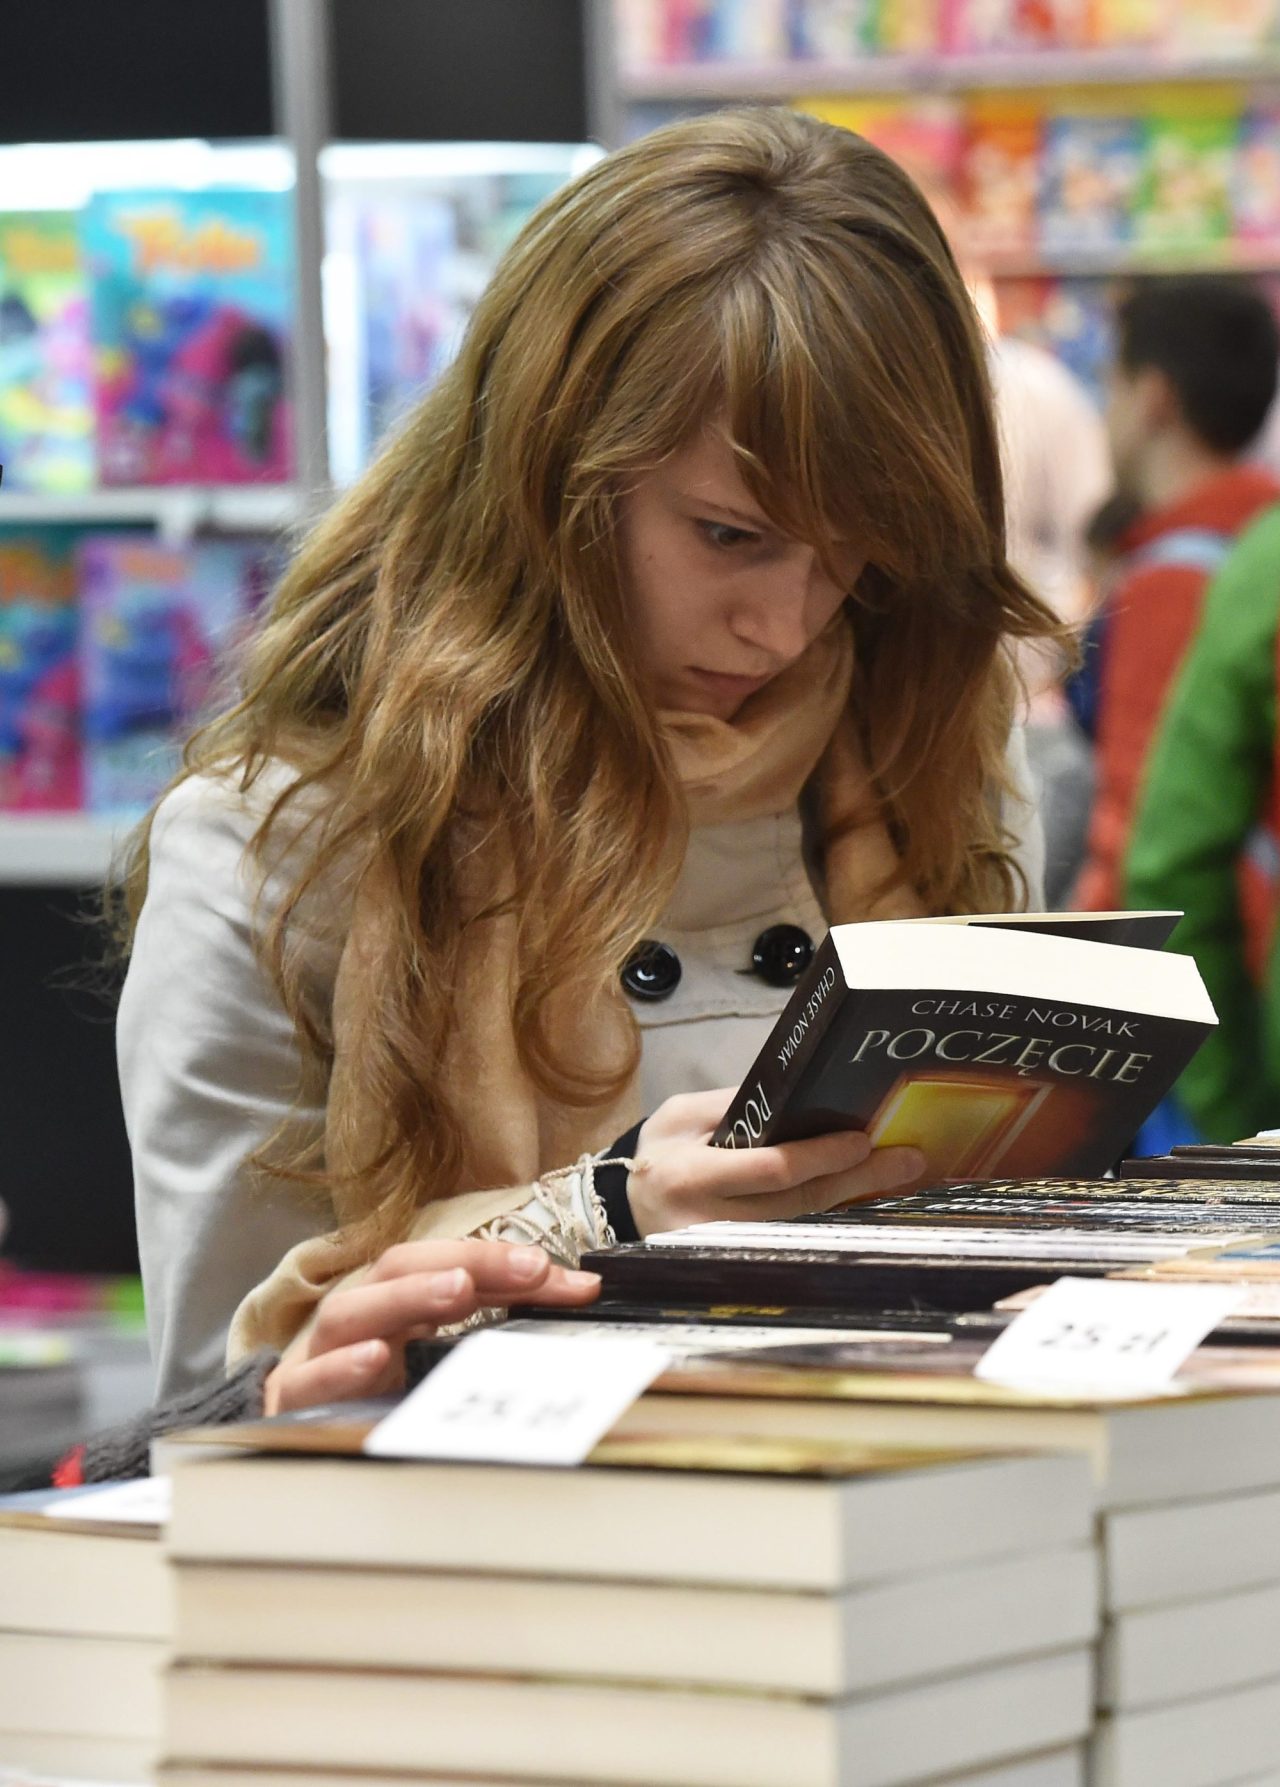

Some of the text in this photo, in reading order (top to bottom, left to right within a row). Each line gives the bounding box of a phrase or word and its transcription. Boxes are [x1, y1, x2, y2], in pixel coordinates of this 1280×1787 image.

[777, 966, 835, 1071] CHASE NOVAK
[911, 999, 1141, 1038] CHASE NOVAK
[848, 1027, 1153, 1084] POCZĘCIE
